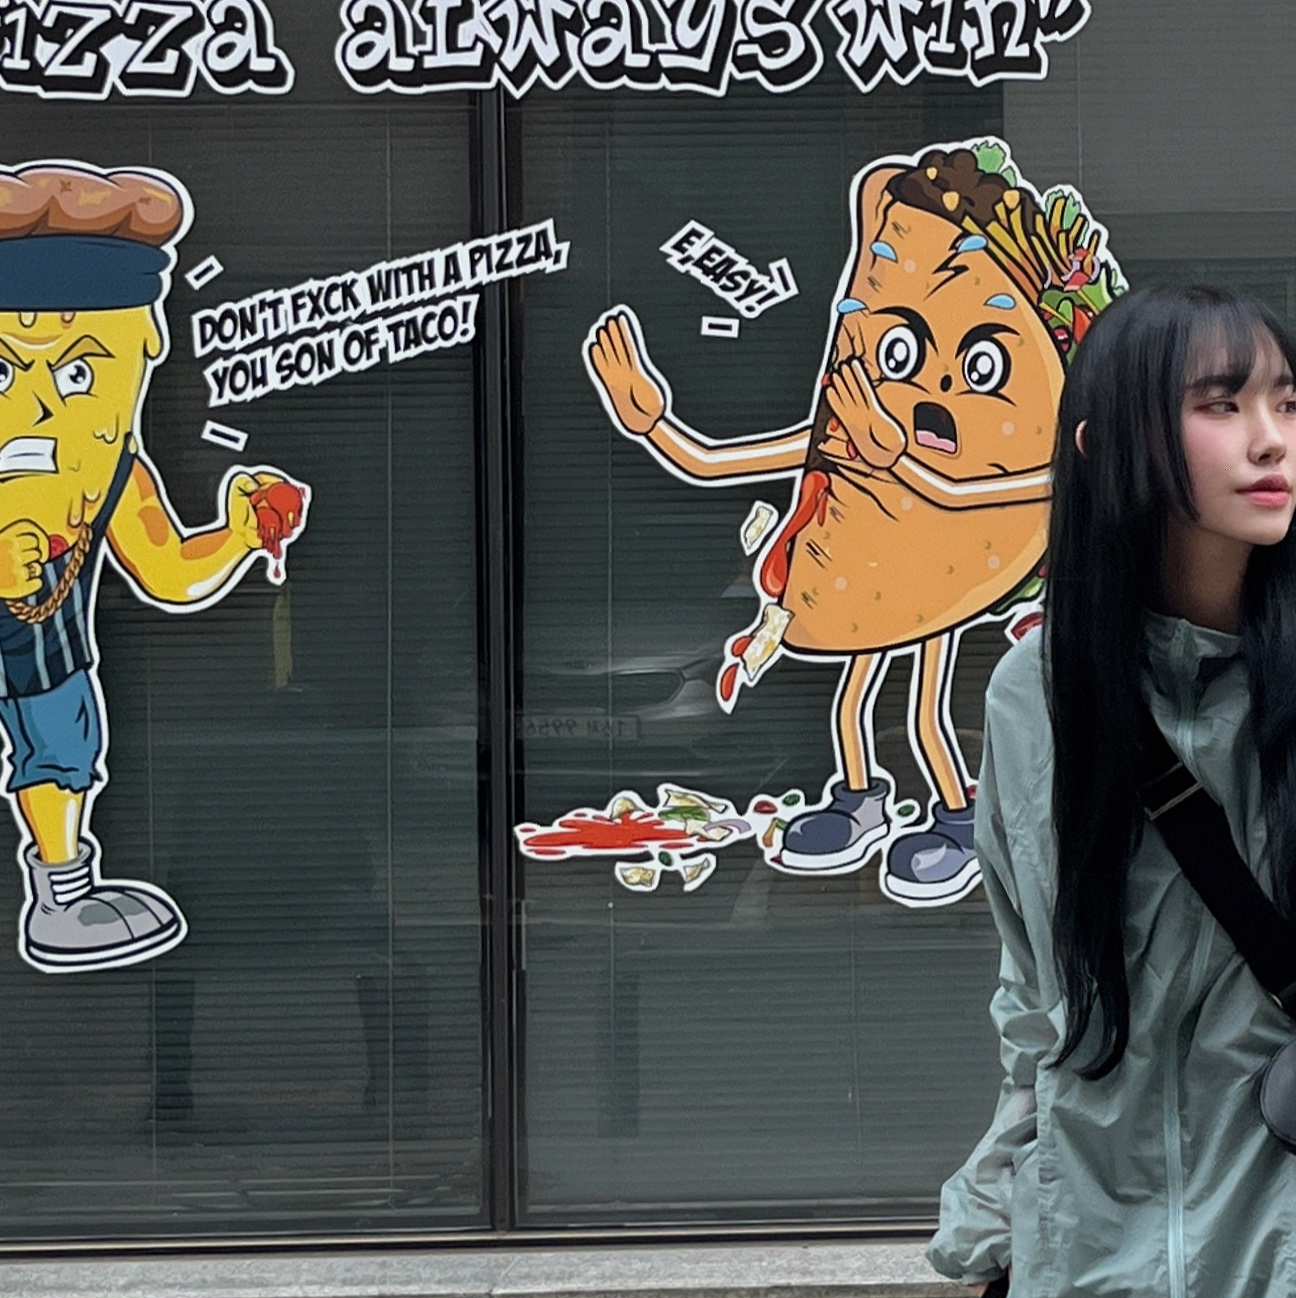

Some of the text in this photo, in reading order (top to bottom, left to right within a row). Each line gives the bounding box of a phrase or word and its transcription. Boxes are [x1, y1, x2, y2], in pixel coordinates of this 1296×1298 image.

[198, 226, 564, 350] DON'T FXCK WITH A PIZZA,
[211, 300, 473, 400] YOU SON OF TACO!
